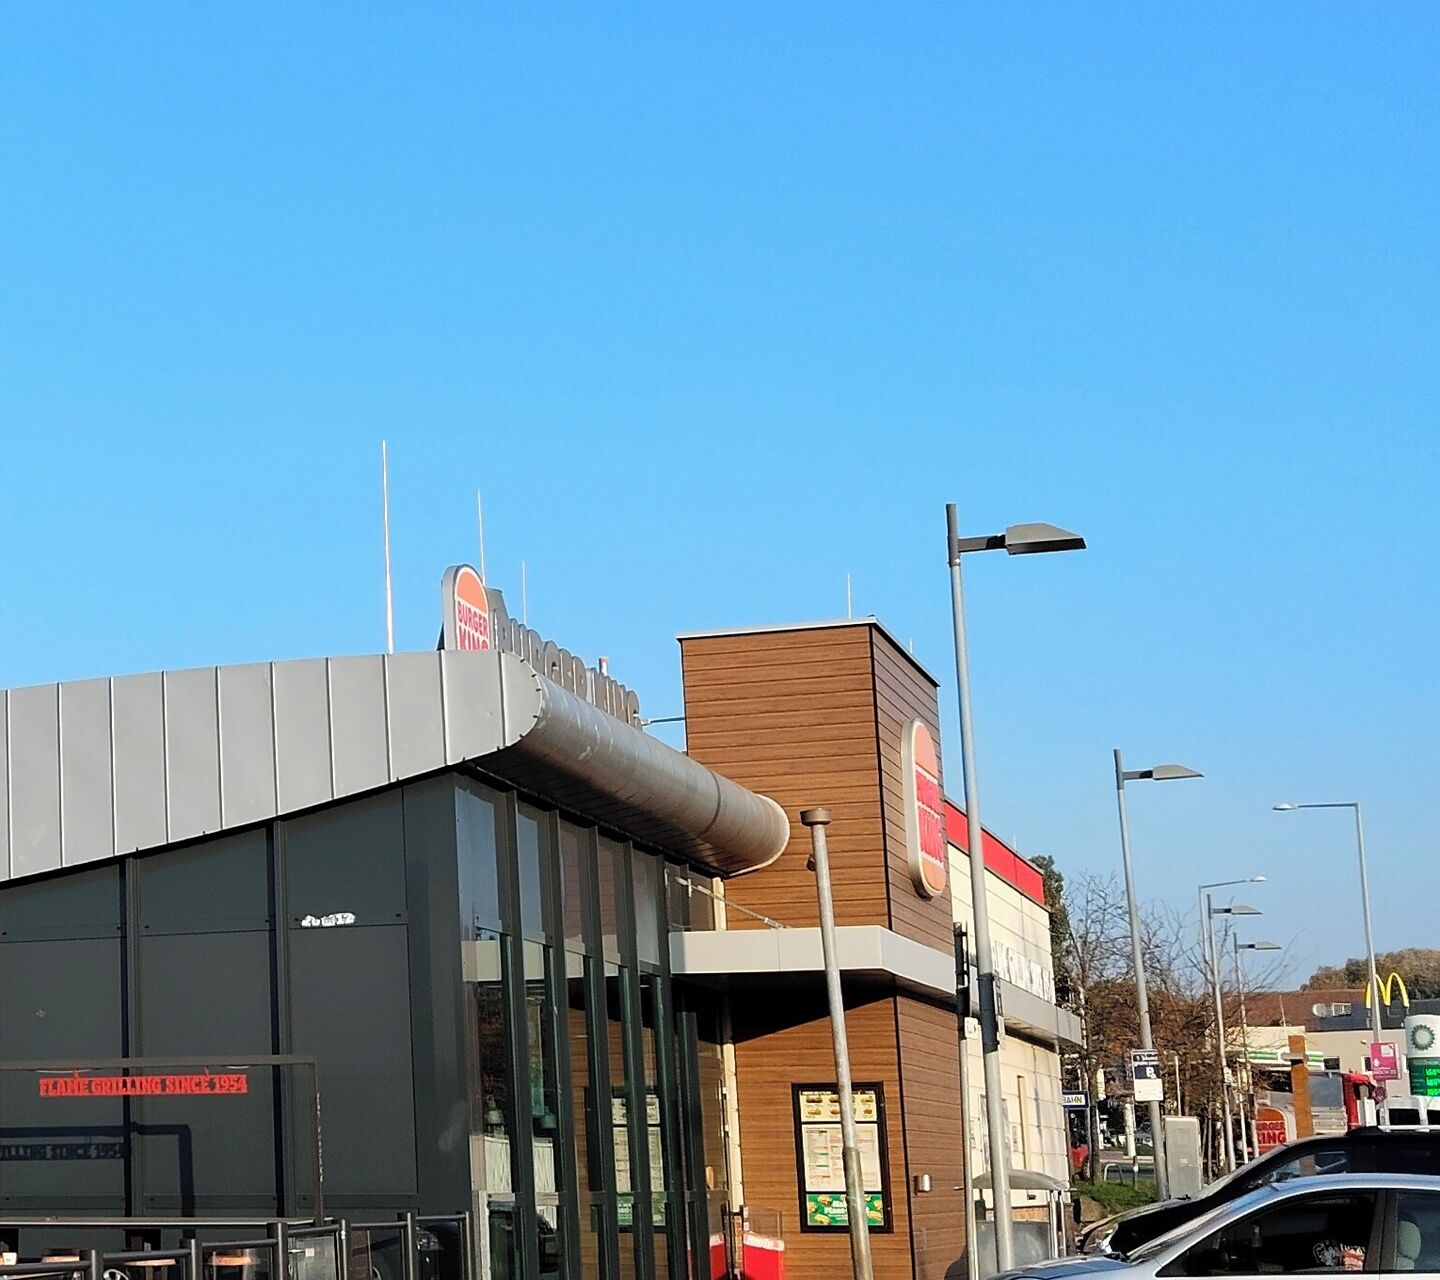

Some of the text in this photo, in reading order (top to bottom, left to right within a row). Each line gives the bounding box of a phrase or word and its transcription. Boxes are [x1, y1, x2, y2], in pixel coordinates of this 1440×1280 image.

[457, 600, 489, 639] BURGER
[39, 1078, 88, 1096] FLAME
[91, 1076, 161, 1096] GRILLING
[166, 1075, 209, 1094] SINCE
